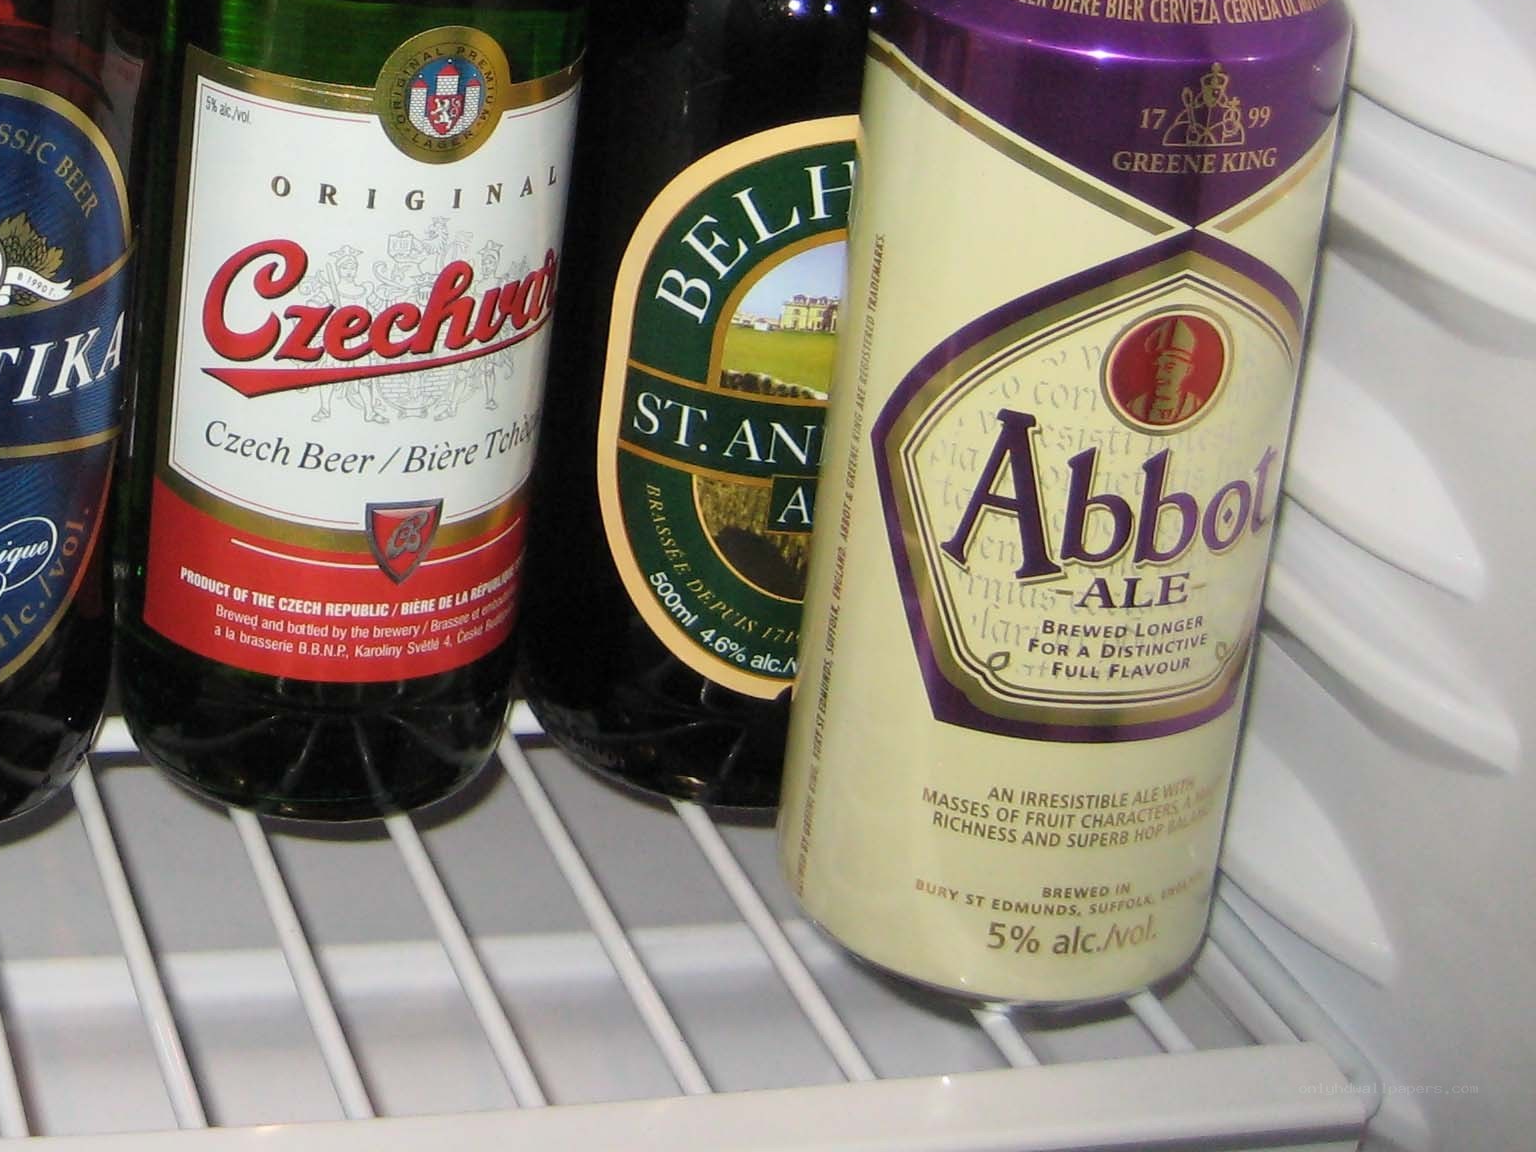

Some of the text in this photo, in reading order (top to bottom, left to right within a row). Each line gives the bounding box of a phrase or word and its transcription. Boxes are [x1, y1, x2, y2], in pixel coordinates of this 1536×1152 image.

[391, 46, 498, 126] ORIGINAL PREMIUM
[1138, 107, 1169, 130] 17
[1247, 104, 1274, 129] 99
[411, 128, 475, 150] LAGER
[1111, 146, 1279, 175] GREENE KING
[52, 157, 101, 219] BEER
[270, 163, 559, 212] ORIGINAL
[204, 419, 478, 475] Czech Beer Bière
[632, 391, 826, 468] ST. AN
[939, 408, 1279, 580] Abbot
[822, 604, 842, 656] SUFFOLK,
[844, 445, 861, 489] GREENE
[179, 566, 232, 599] PRODUCT
[232, 586, 250, 603] OF
[251, 589, 276, 609] THE
[277, 596, 323, 616] CZECH
[324, 602, 390, 618] REPUBLIC
[400, 597, 437, 618] BIÈRE
[438, 594, 454, 611] DE
[454, 589, 470, 608] LA
[685, 577, 759, 635] DEPUIS
[1074, 572, 1190, 610] ALE
[215, 603, 421, 641] Brewed and bottled by the brewery
[649, 570, 700, 628] 500ml
[699, 628, 748, 664] 4.6%
[1041, 618, 1128, 640] BREWED
[1134, 615, 1204, 638] LONGER
[224, 626, 237, 642] la
[238, 629, 295, 654] brasserie
[353, 642, 404, 660] Karoliny
[1027, 632, 1208, 660] FOR A DISTINCTIVE
[1051, 656, 1191, 680] FULL FLAVOUR
[921, 786, 1075, 830] MASSES OF FRUIT
[986, 785, 1160, 810] AN IRRESISTIBLE ALE
[931, 810, 1018, 845] RICHNESS
[1021, 832, 1062, 849] AND
[1066, 828, 1130, 849] SUPERB
[914, 878, 960, 903] BURY
[965, 893, 985, 908] ST
[990, 898, 1083, 919] EDMUNDS,
[1041, 881, 1132, 900] BREWED IN
[986, 914, 1159, 956] 5% alc./vol.
